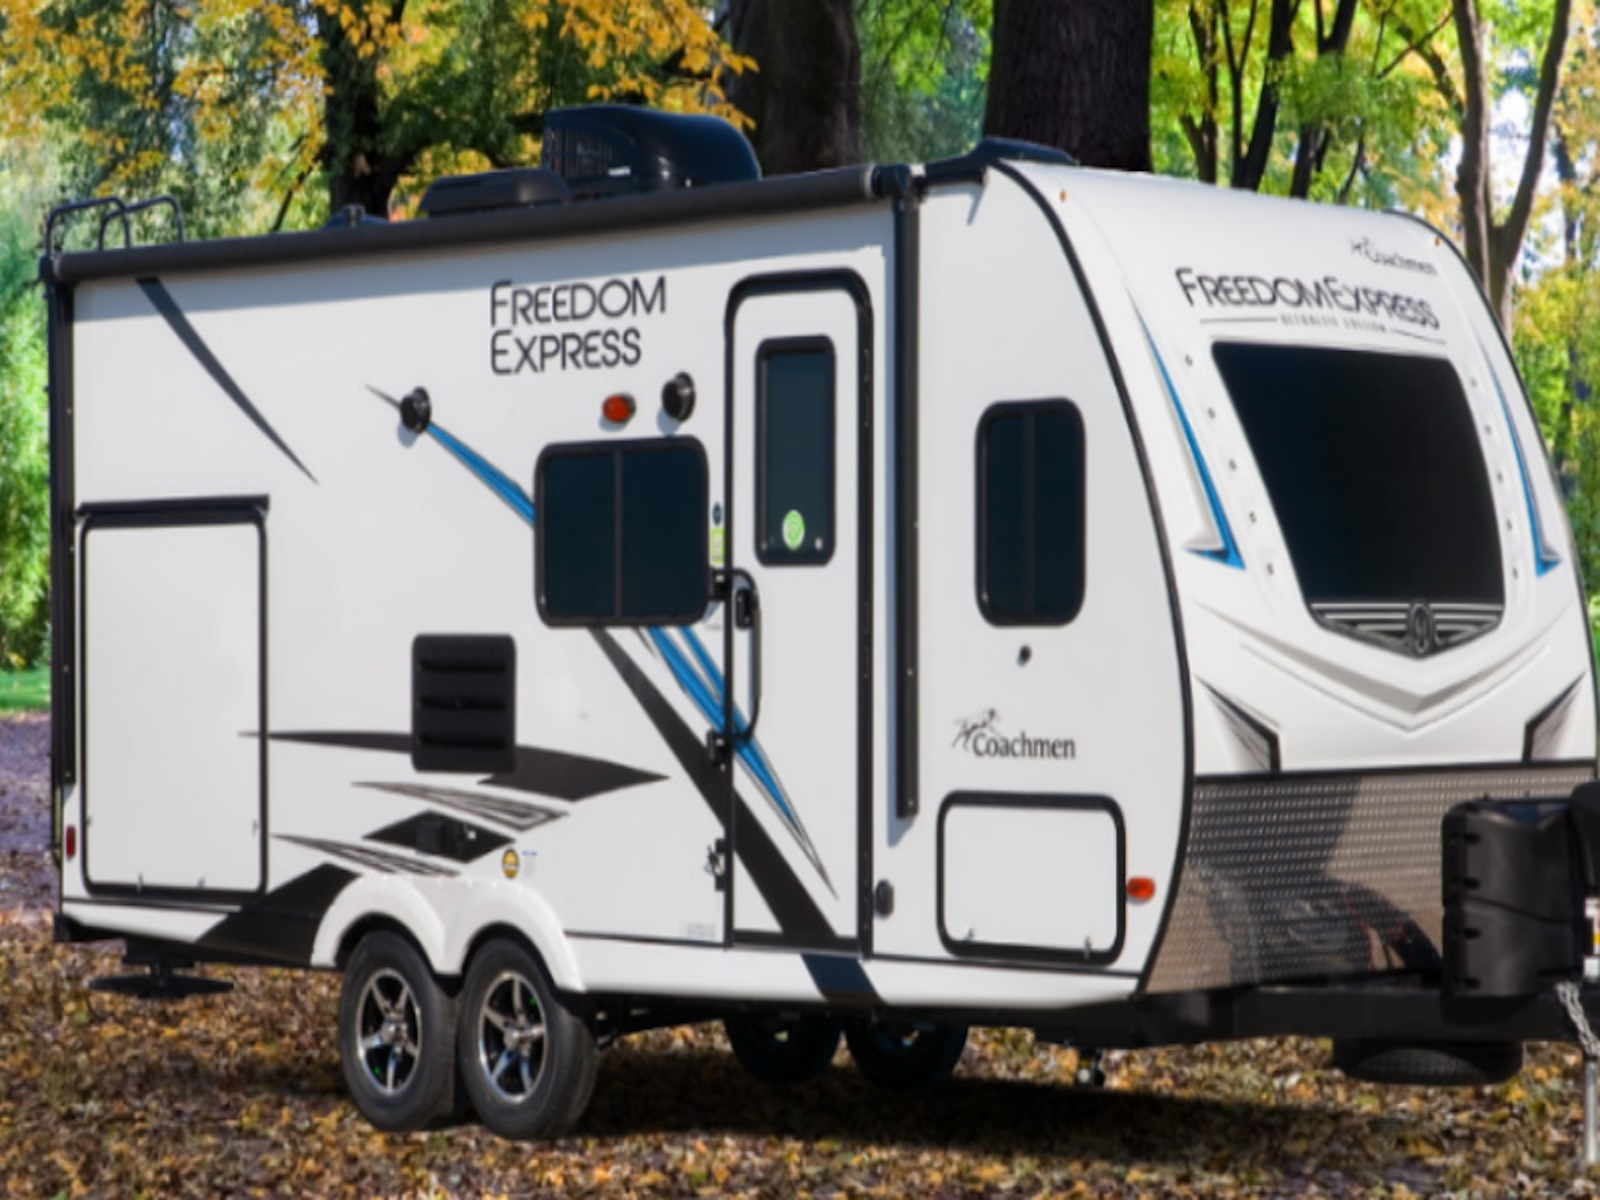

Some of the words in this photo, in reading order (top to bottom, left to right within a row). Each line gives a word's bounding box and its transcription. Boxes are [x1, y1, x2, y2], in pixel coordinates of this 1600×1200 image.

[491, 275, 667, 327] FREEDOM
[491, 326, 642, 375] EXPRESS
[972, 730, 1076, 759] Coachmen
